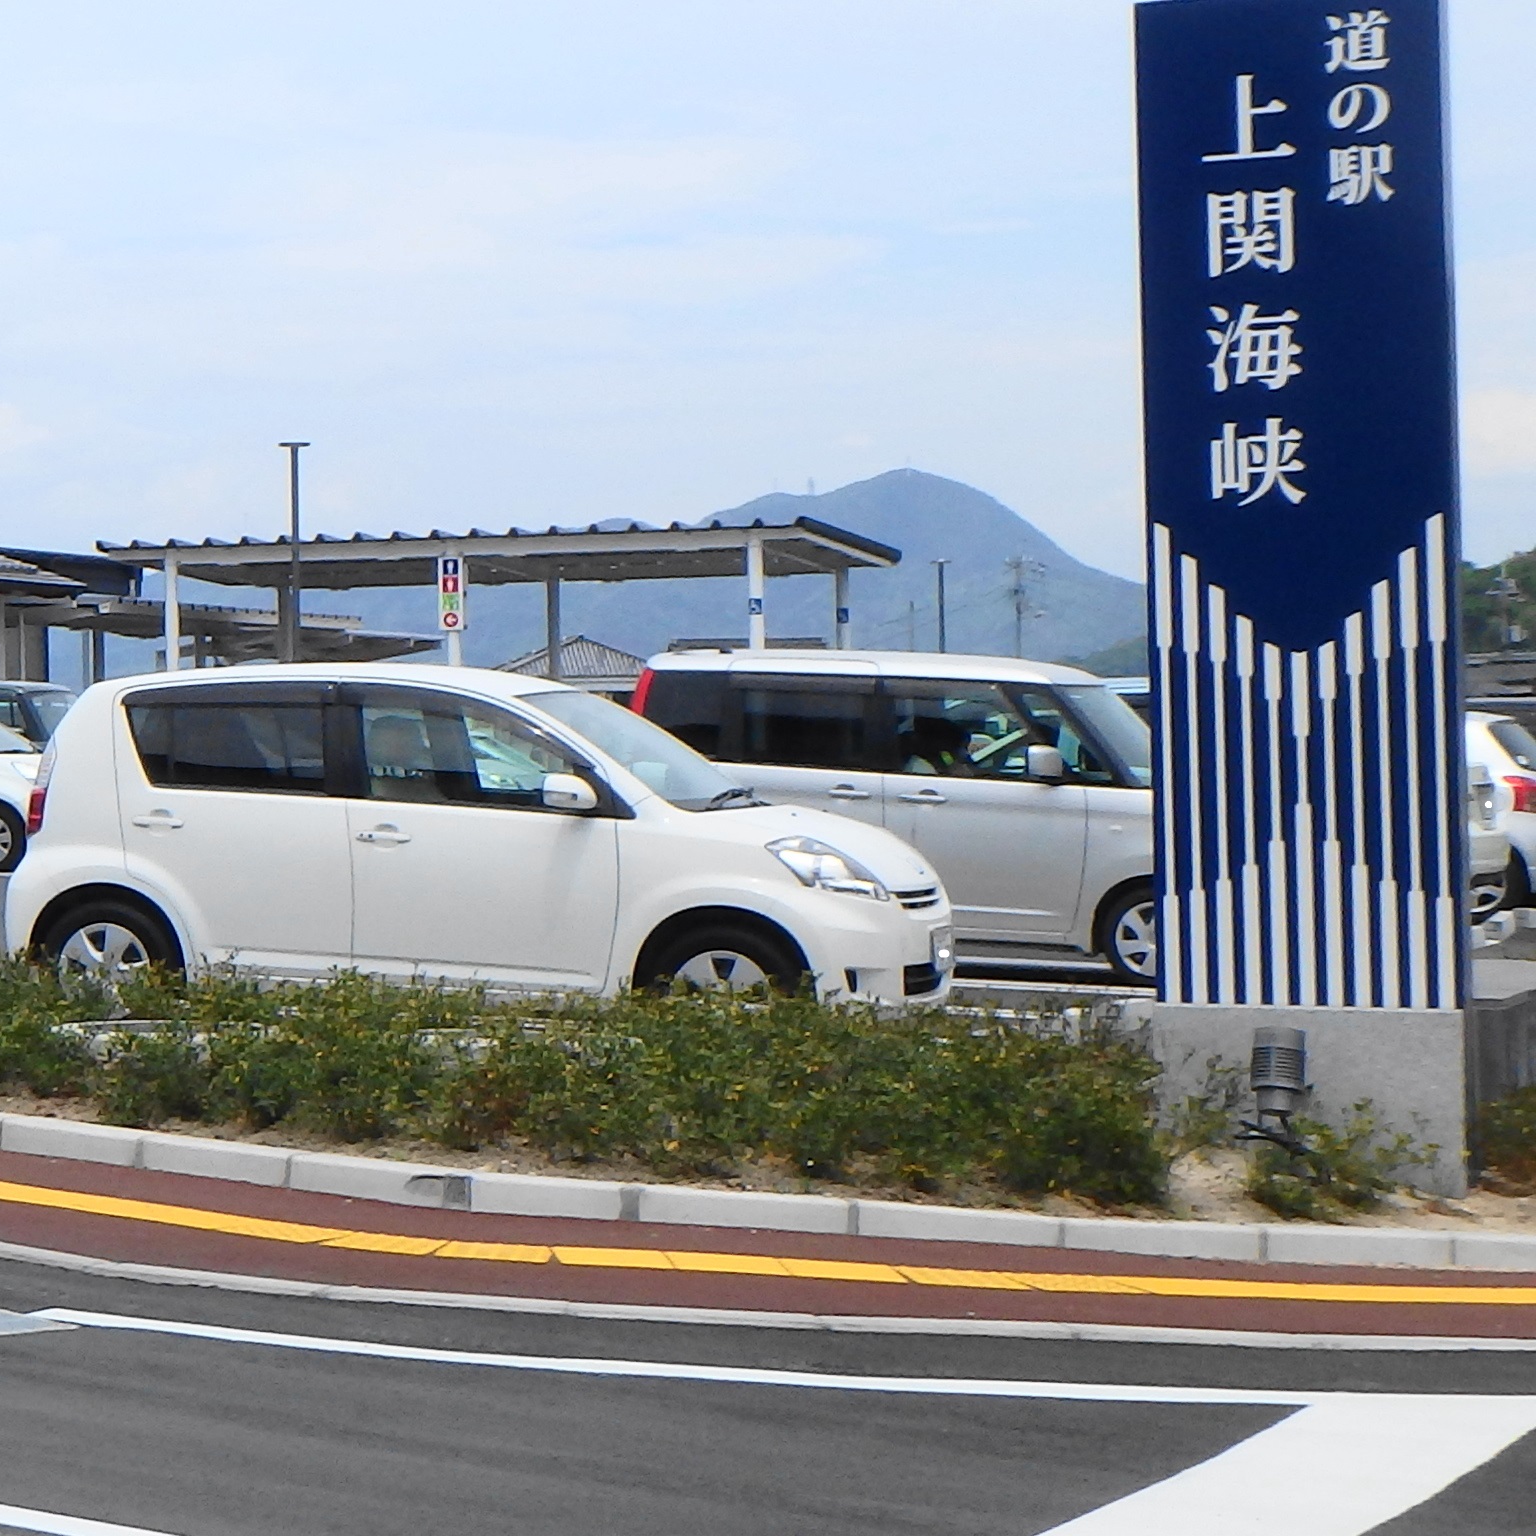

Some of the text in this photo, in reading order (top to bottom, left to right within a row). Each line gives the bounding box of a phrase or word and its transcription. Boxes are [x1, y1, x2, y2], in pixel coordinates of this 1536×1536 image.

[1324, 9, 1395, 206] 道の駅
[1201, 74, 1308, 508] 上関海峡
